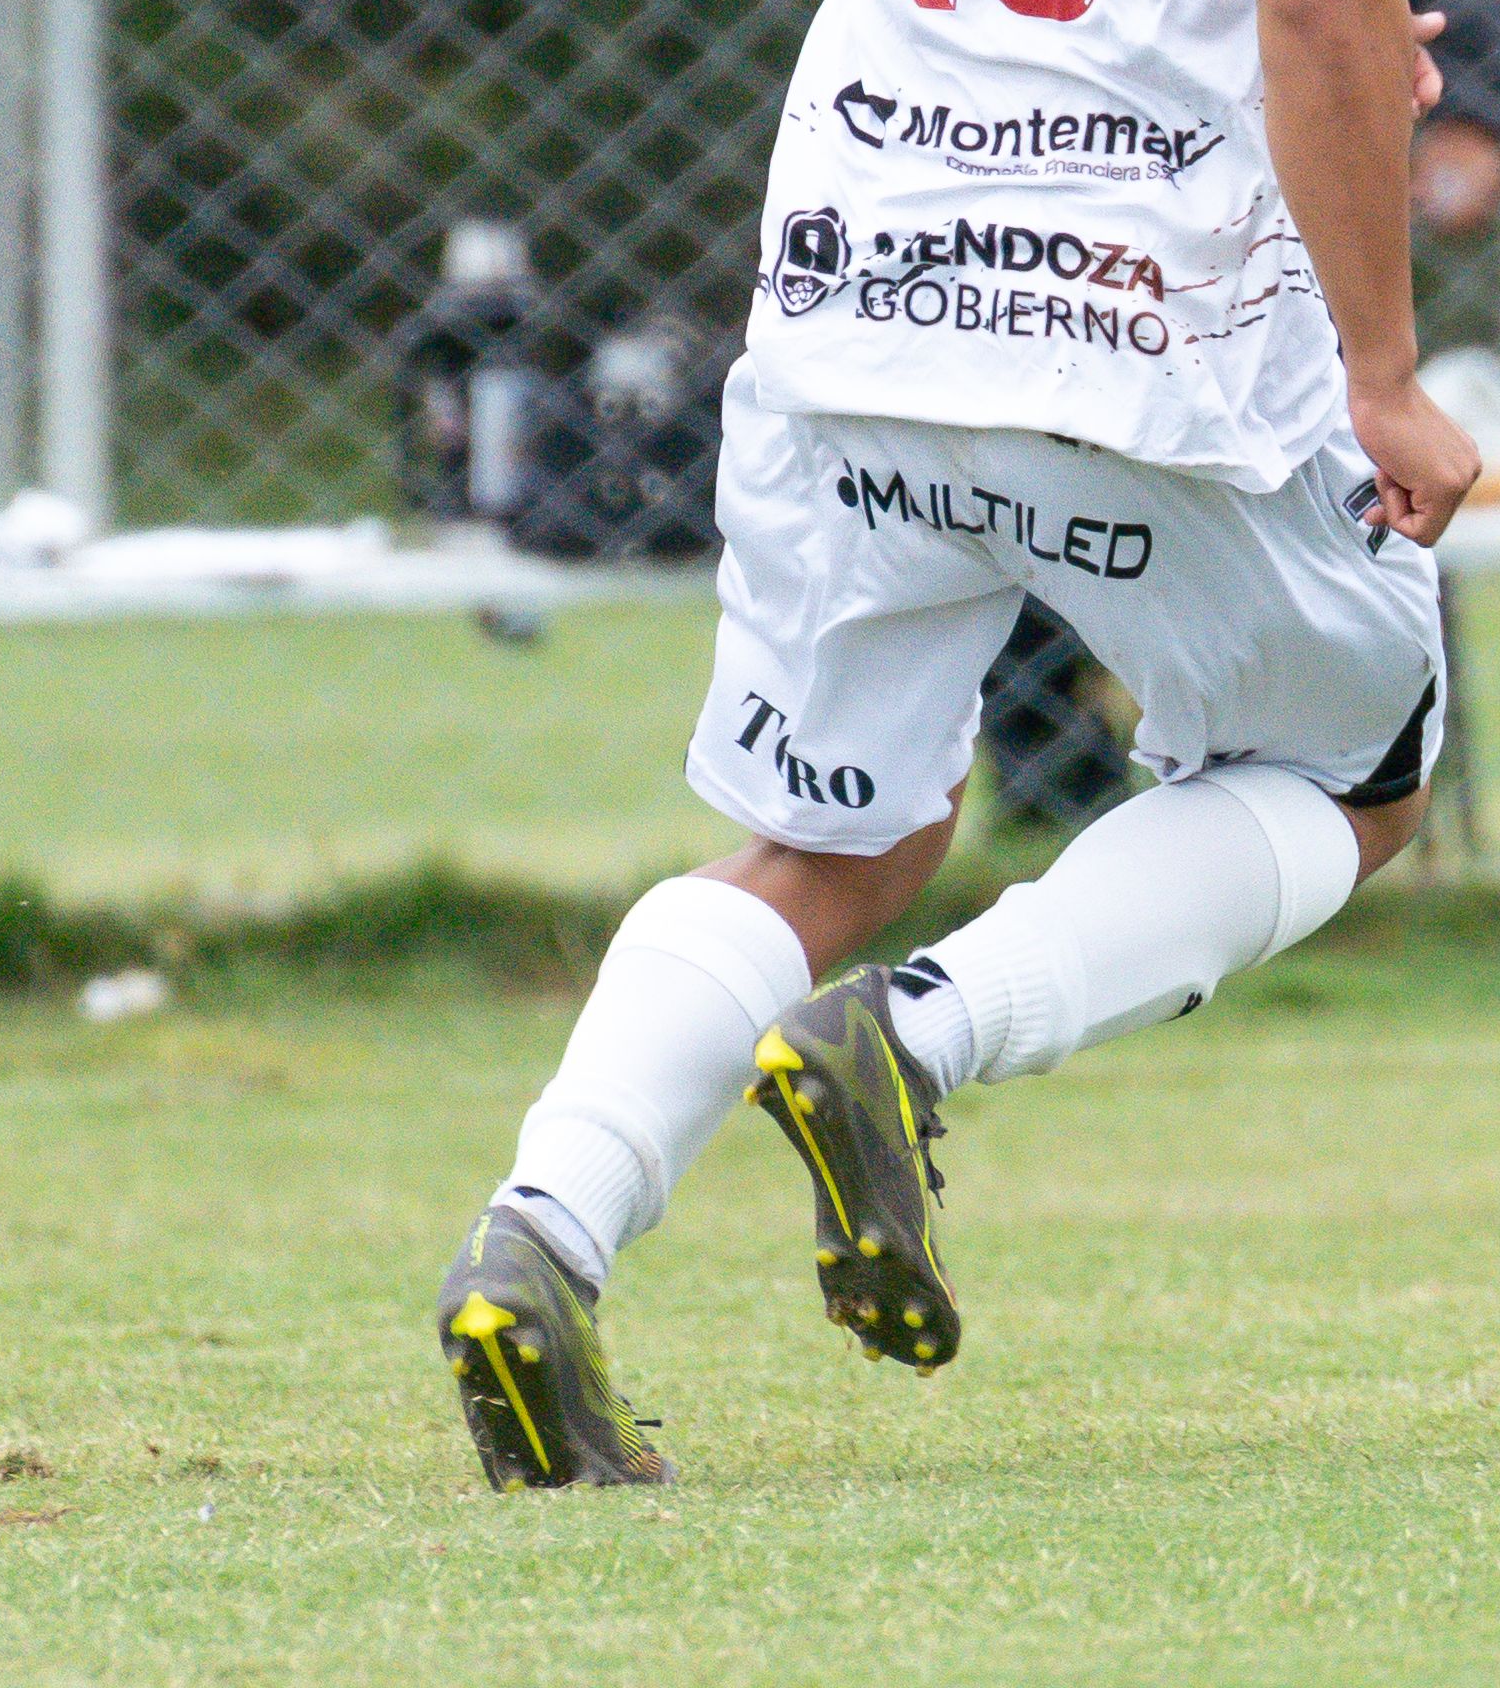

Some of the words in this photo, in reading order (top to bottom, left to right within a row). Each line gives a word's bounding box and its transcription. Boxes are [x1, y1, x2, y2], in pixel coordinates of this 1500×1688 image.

[900, 105, 1198, 169] Montemar
[860, 278, 1169, 356] GOBIERNO
[860, 467, 1153, 580] MULTILED
